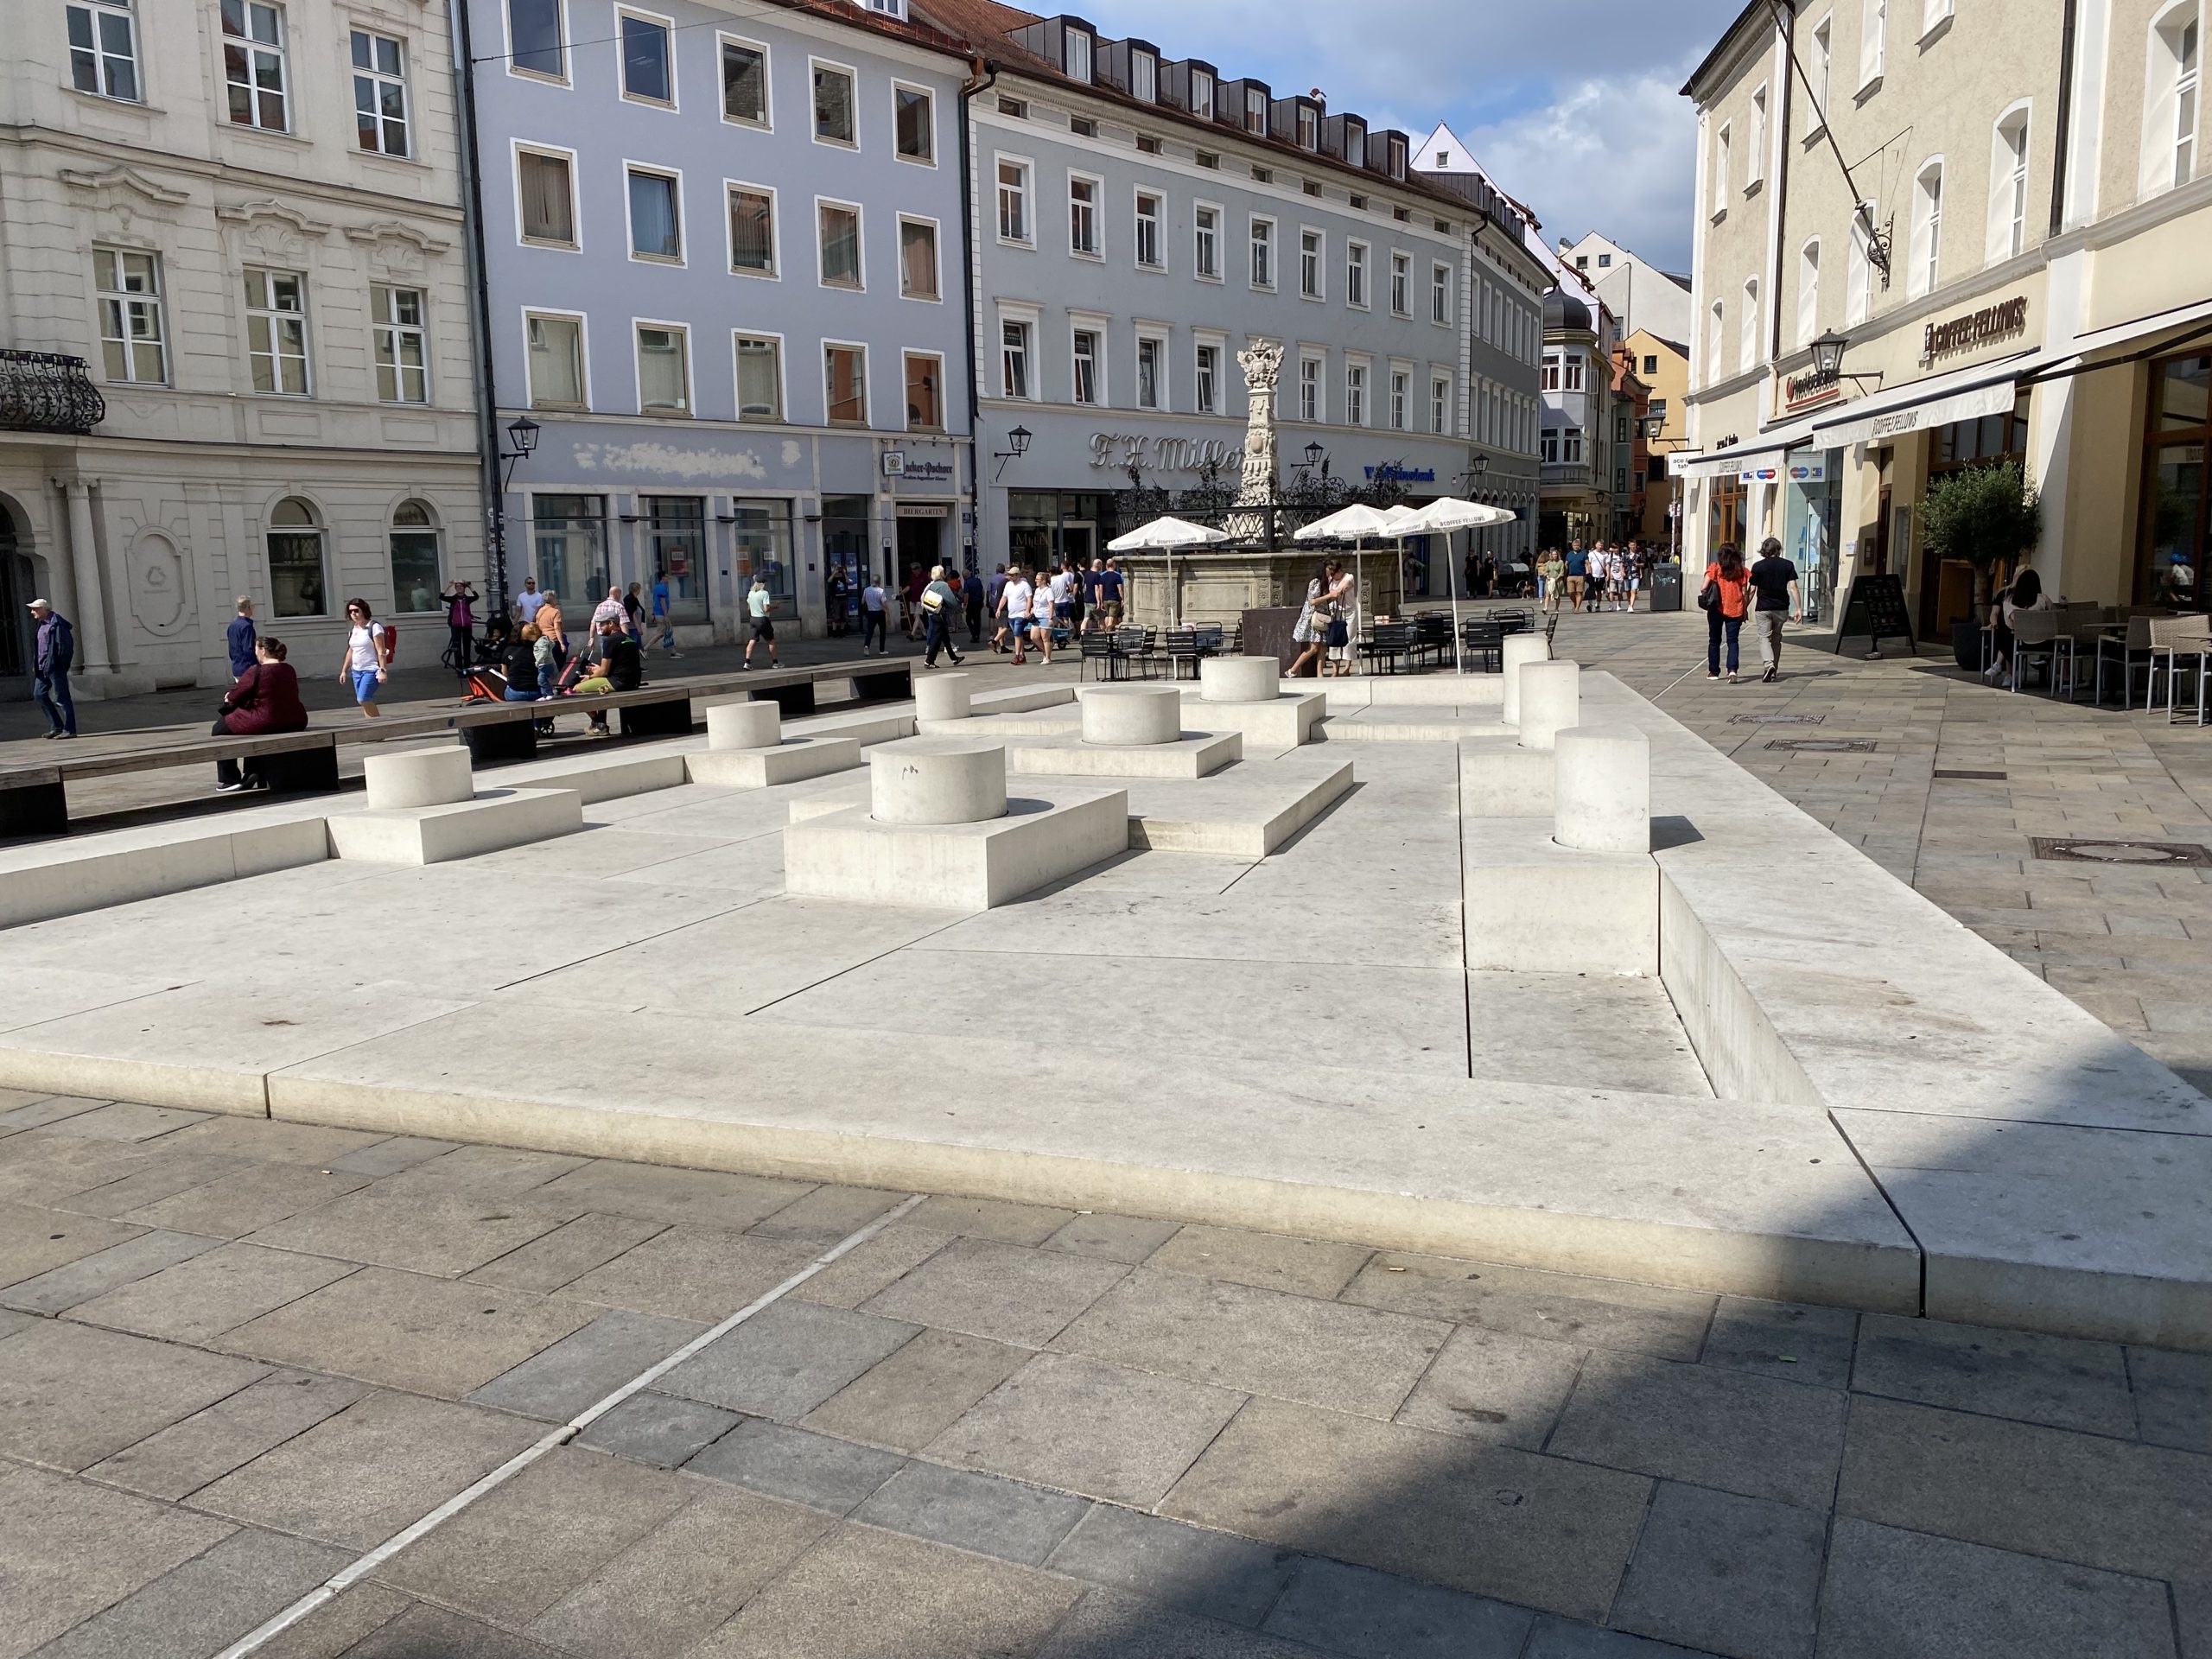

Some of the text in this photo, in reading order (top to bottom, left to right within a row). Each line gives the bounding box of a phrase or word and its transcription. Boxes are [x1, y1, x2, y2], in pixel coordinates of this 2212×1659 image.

[1935, 296, 2027, 352] COFFEE FELLOWS
[906, 461, 953, 476] acker-Pschorr
[1444, 518, 1462, 527] COFFEE
